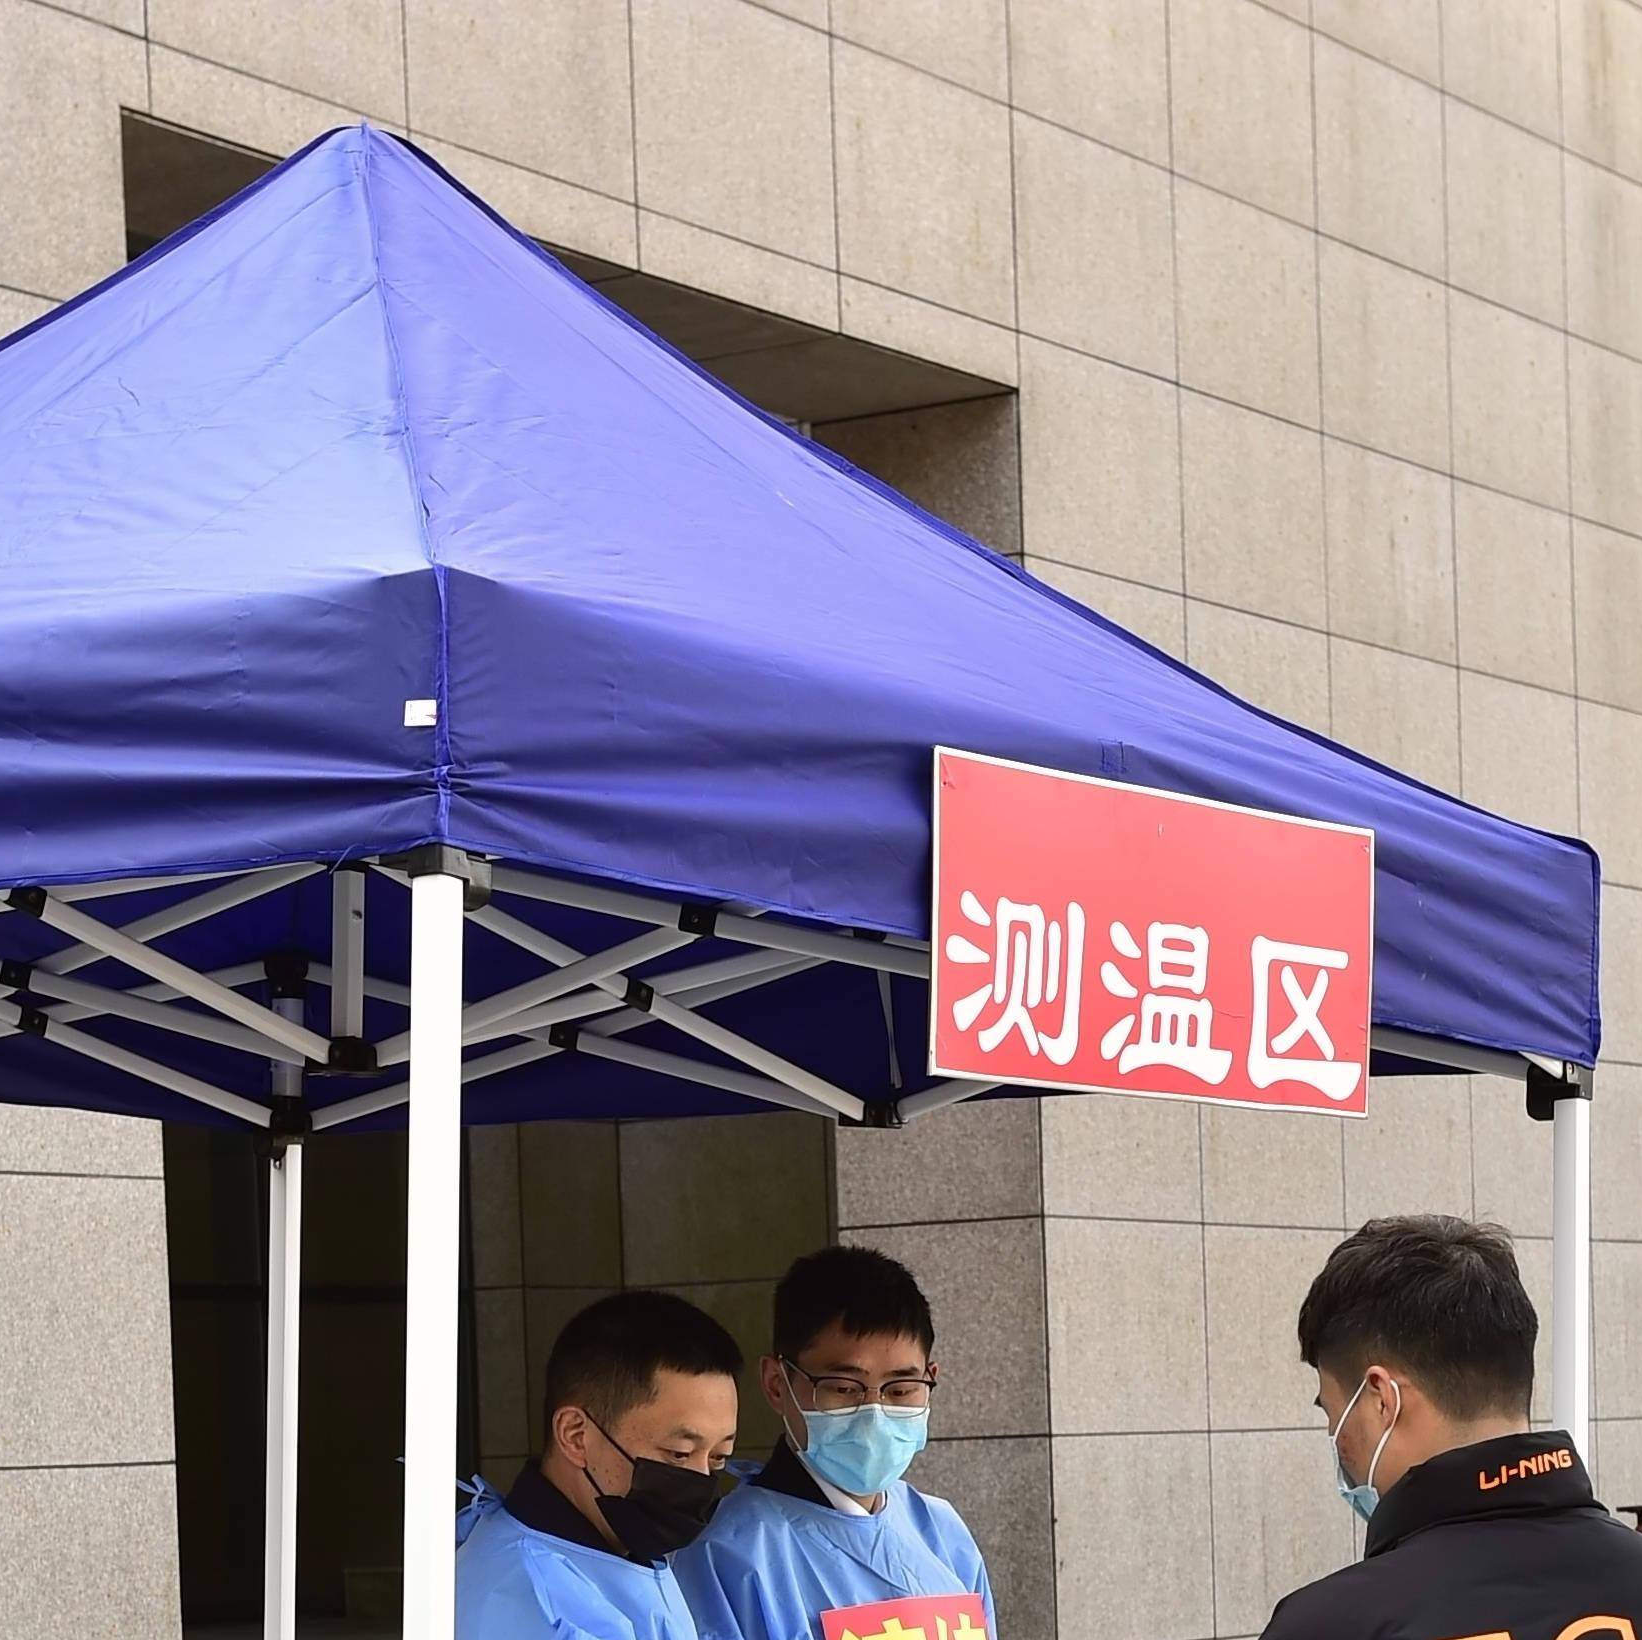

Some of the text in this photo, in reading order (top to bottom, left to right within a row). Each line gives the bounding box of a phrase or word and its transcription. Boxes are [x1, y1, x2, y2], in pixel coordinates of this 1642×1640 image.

[945, 890, 1362, 1101] 测温区
[1479, 1448, 1573, 1490] LI-NING
